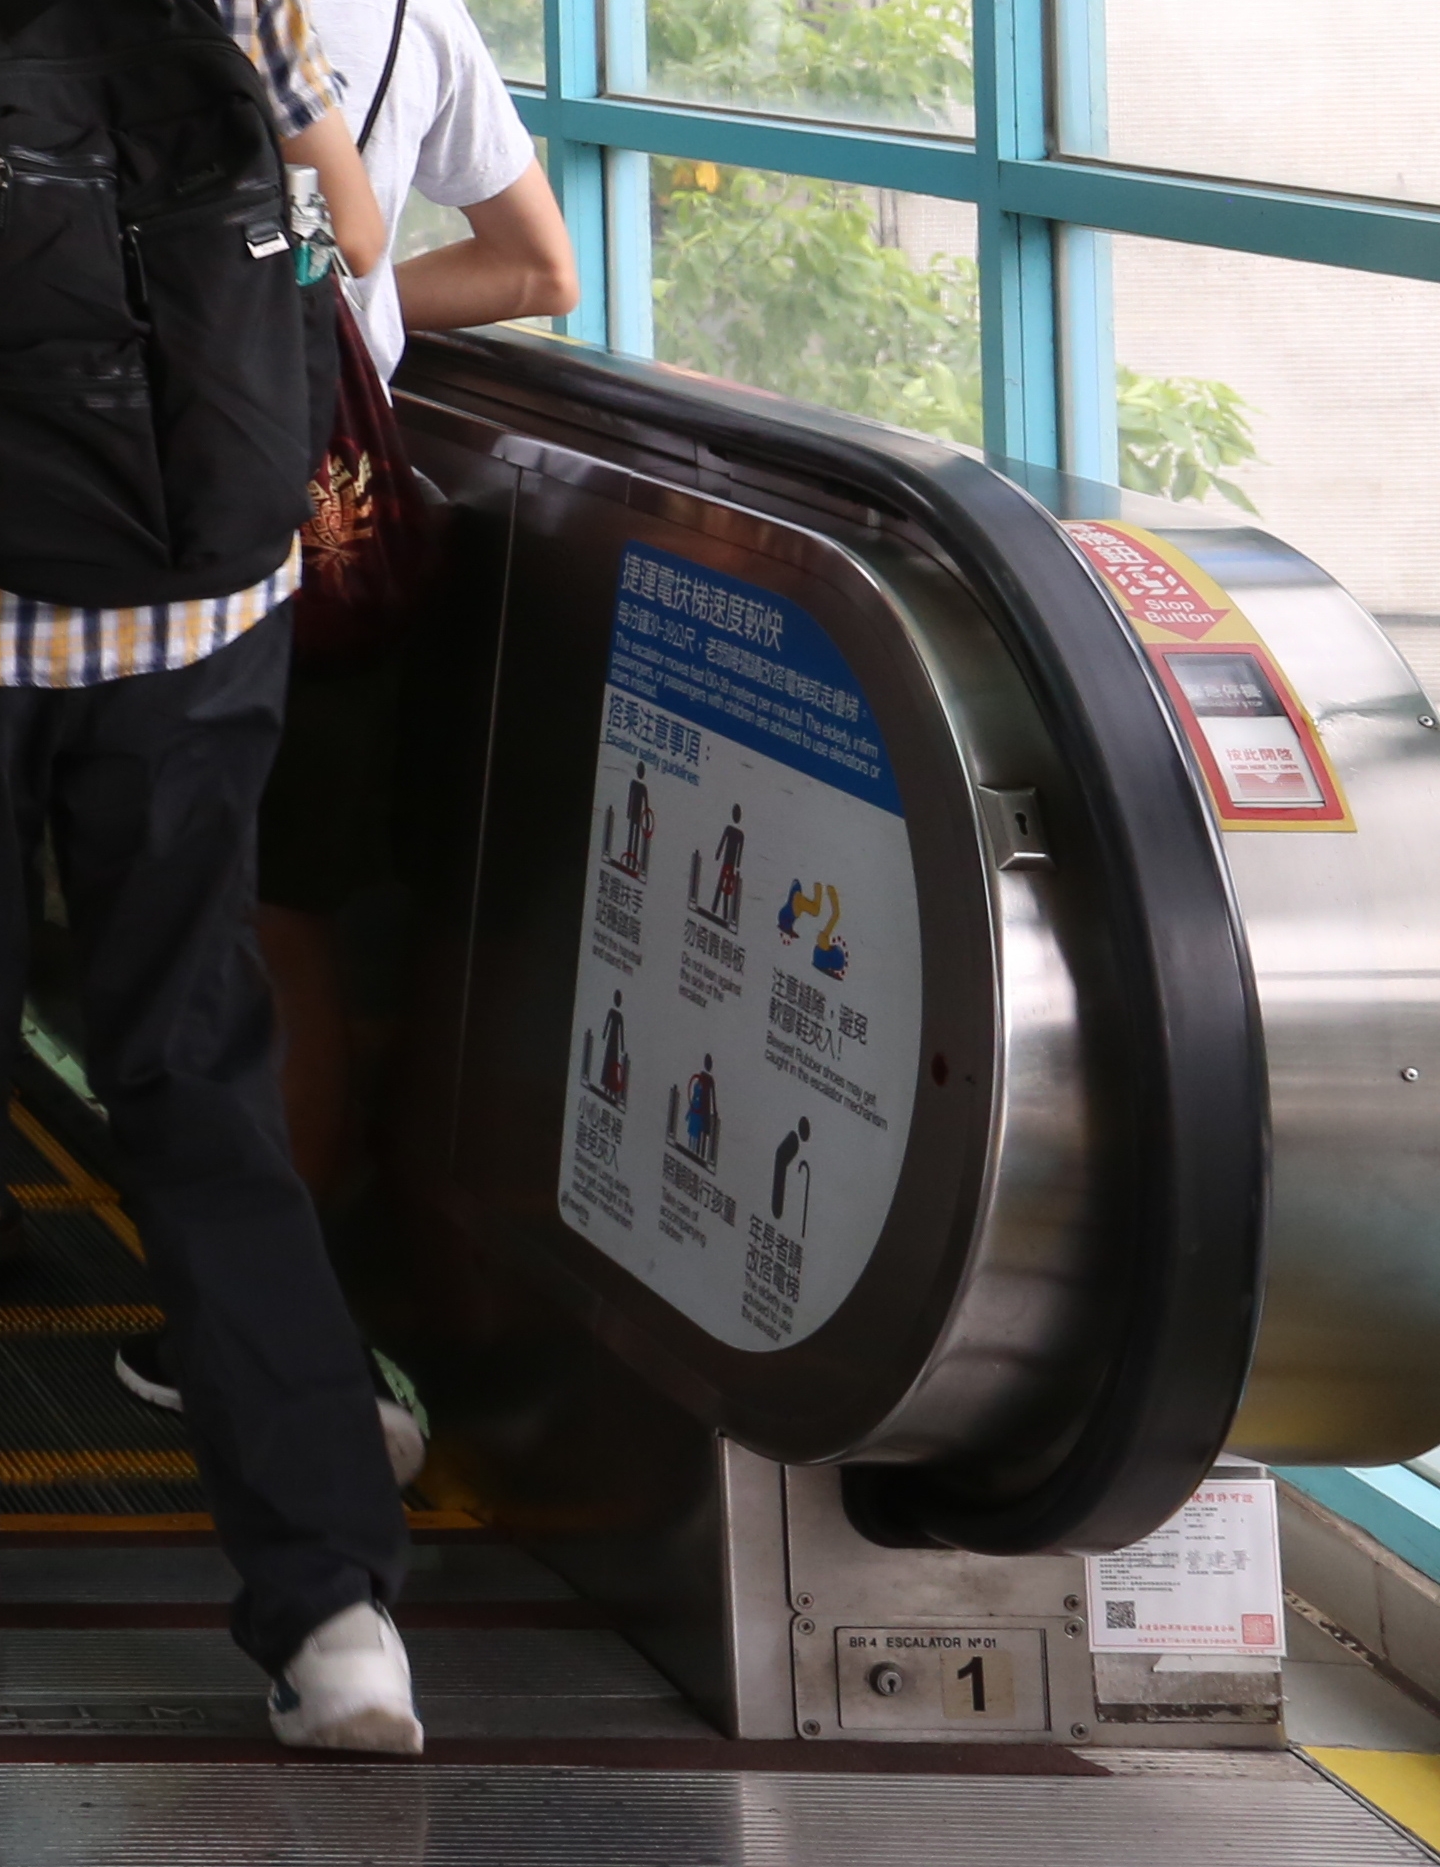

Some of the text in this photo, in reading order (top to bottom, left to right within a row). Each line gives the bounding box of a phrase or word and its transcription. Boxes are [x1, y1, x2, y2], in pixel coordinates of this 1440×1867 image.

[621, 550, 784, 652] 捷運電扶梯速度較快
[1145, 599, 1195, 612] Stop
[1144, 611, 1216, 623] Button
[850, 1637, 866, 1647] BR
[870, 1637, 877, 1647] 4
[887, 1637, 961, 1648] ESCALATOR
[957, 1656, 986, 1712] 1
